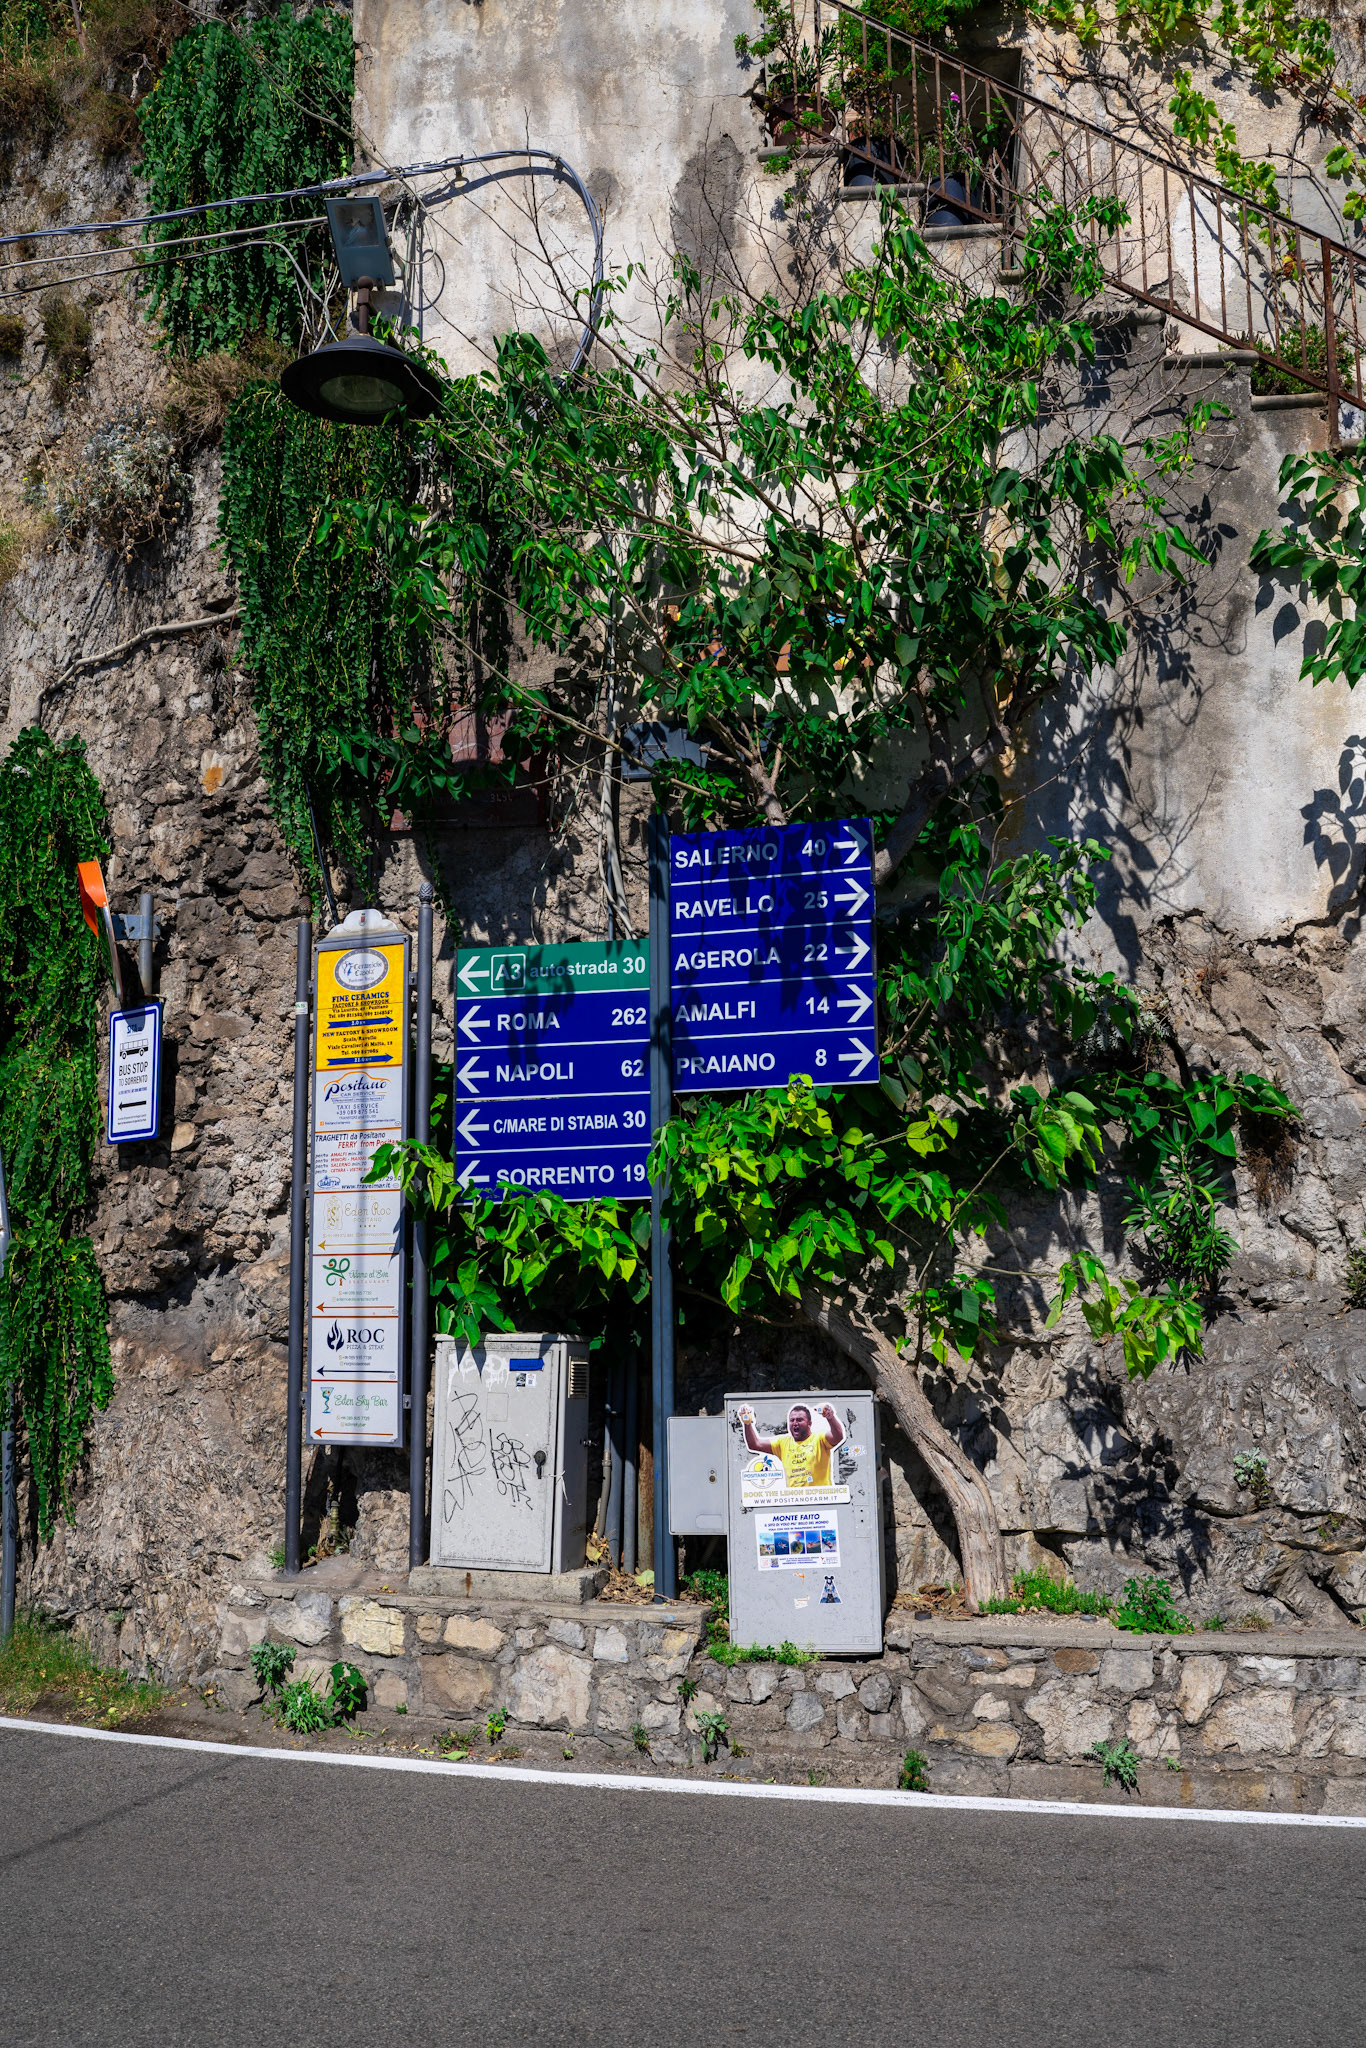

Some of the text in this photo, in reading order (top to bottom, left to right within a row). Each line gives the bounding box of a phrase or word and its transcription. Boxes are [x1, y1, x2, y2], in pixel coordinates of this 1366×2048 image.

[674, 839, 826, 869] SALERNO 40
[675, 891, 828, 919] RAVELLO 25
[674, 943, 828, 971] AGEROLA 22
[495, 956, 646, 981] A3 autostrada 30
[351, 992, 389, 1000] CERAMICS
[497, 1008, 647, 1031] ROMA 262
[674, 996, 829, 1022] AMALFI 14
[119, 1061, 149, 1076] BUS STOP
[496, 1059, 645, 1082] NAPOLI 62
[676, 1049, 827, 1075] PRAIANO 8
[118, 1074, 148, 1087] TO SORRENTO
[493, 1110, 646, 1134] C/MARE DI STABIA 30
[316, 1134, 348, 1142] TRAGHETTI
[360, 1132, 385, 1140] Positano
[496, 1164, 646, 1186] SORRENTO 19
[345, 1202, 391, 1216] Eden Roc
[347, 1329, 384, 1343] ROC
[334, 1394, 388, 1411] Eden Sky Bar
[754, 1496, 837, 1504] WWW.POSITANOFARM.IT
